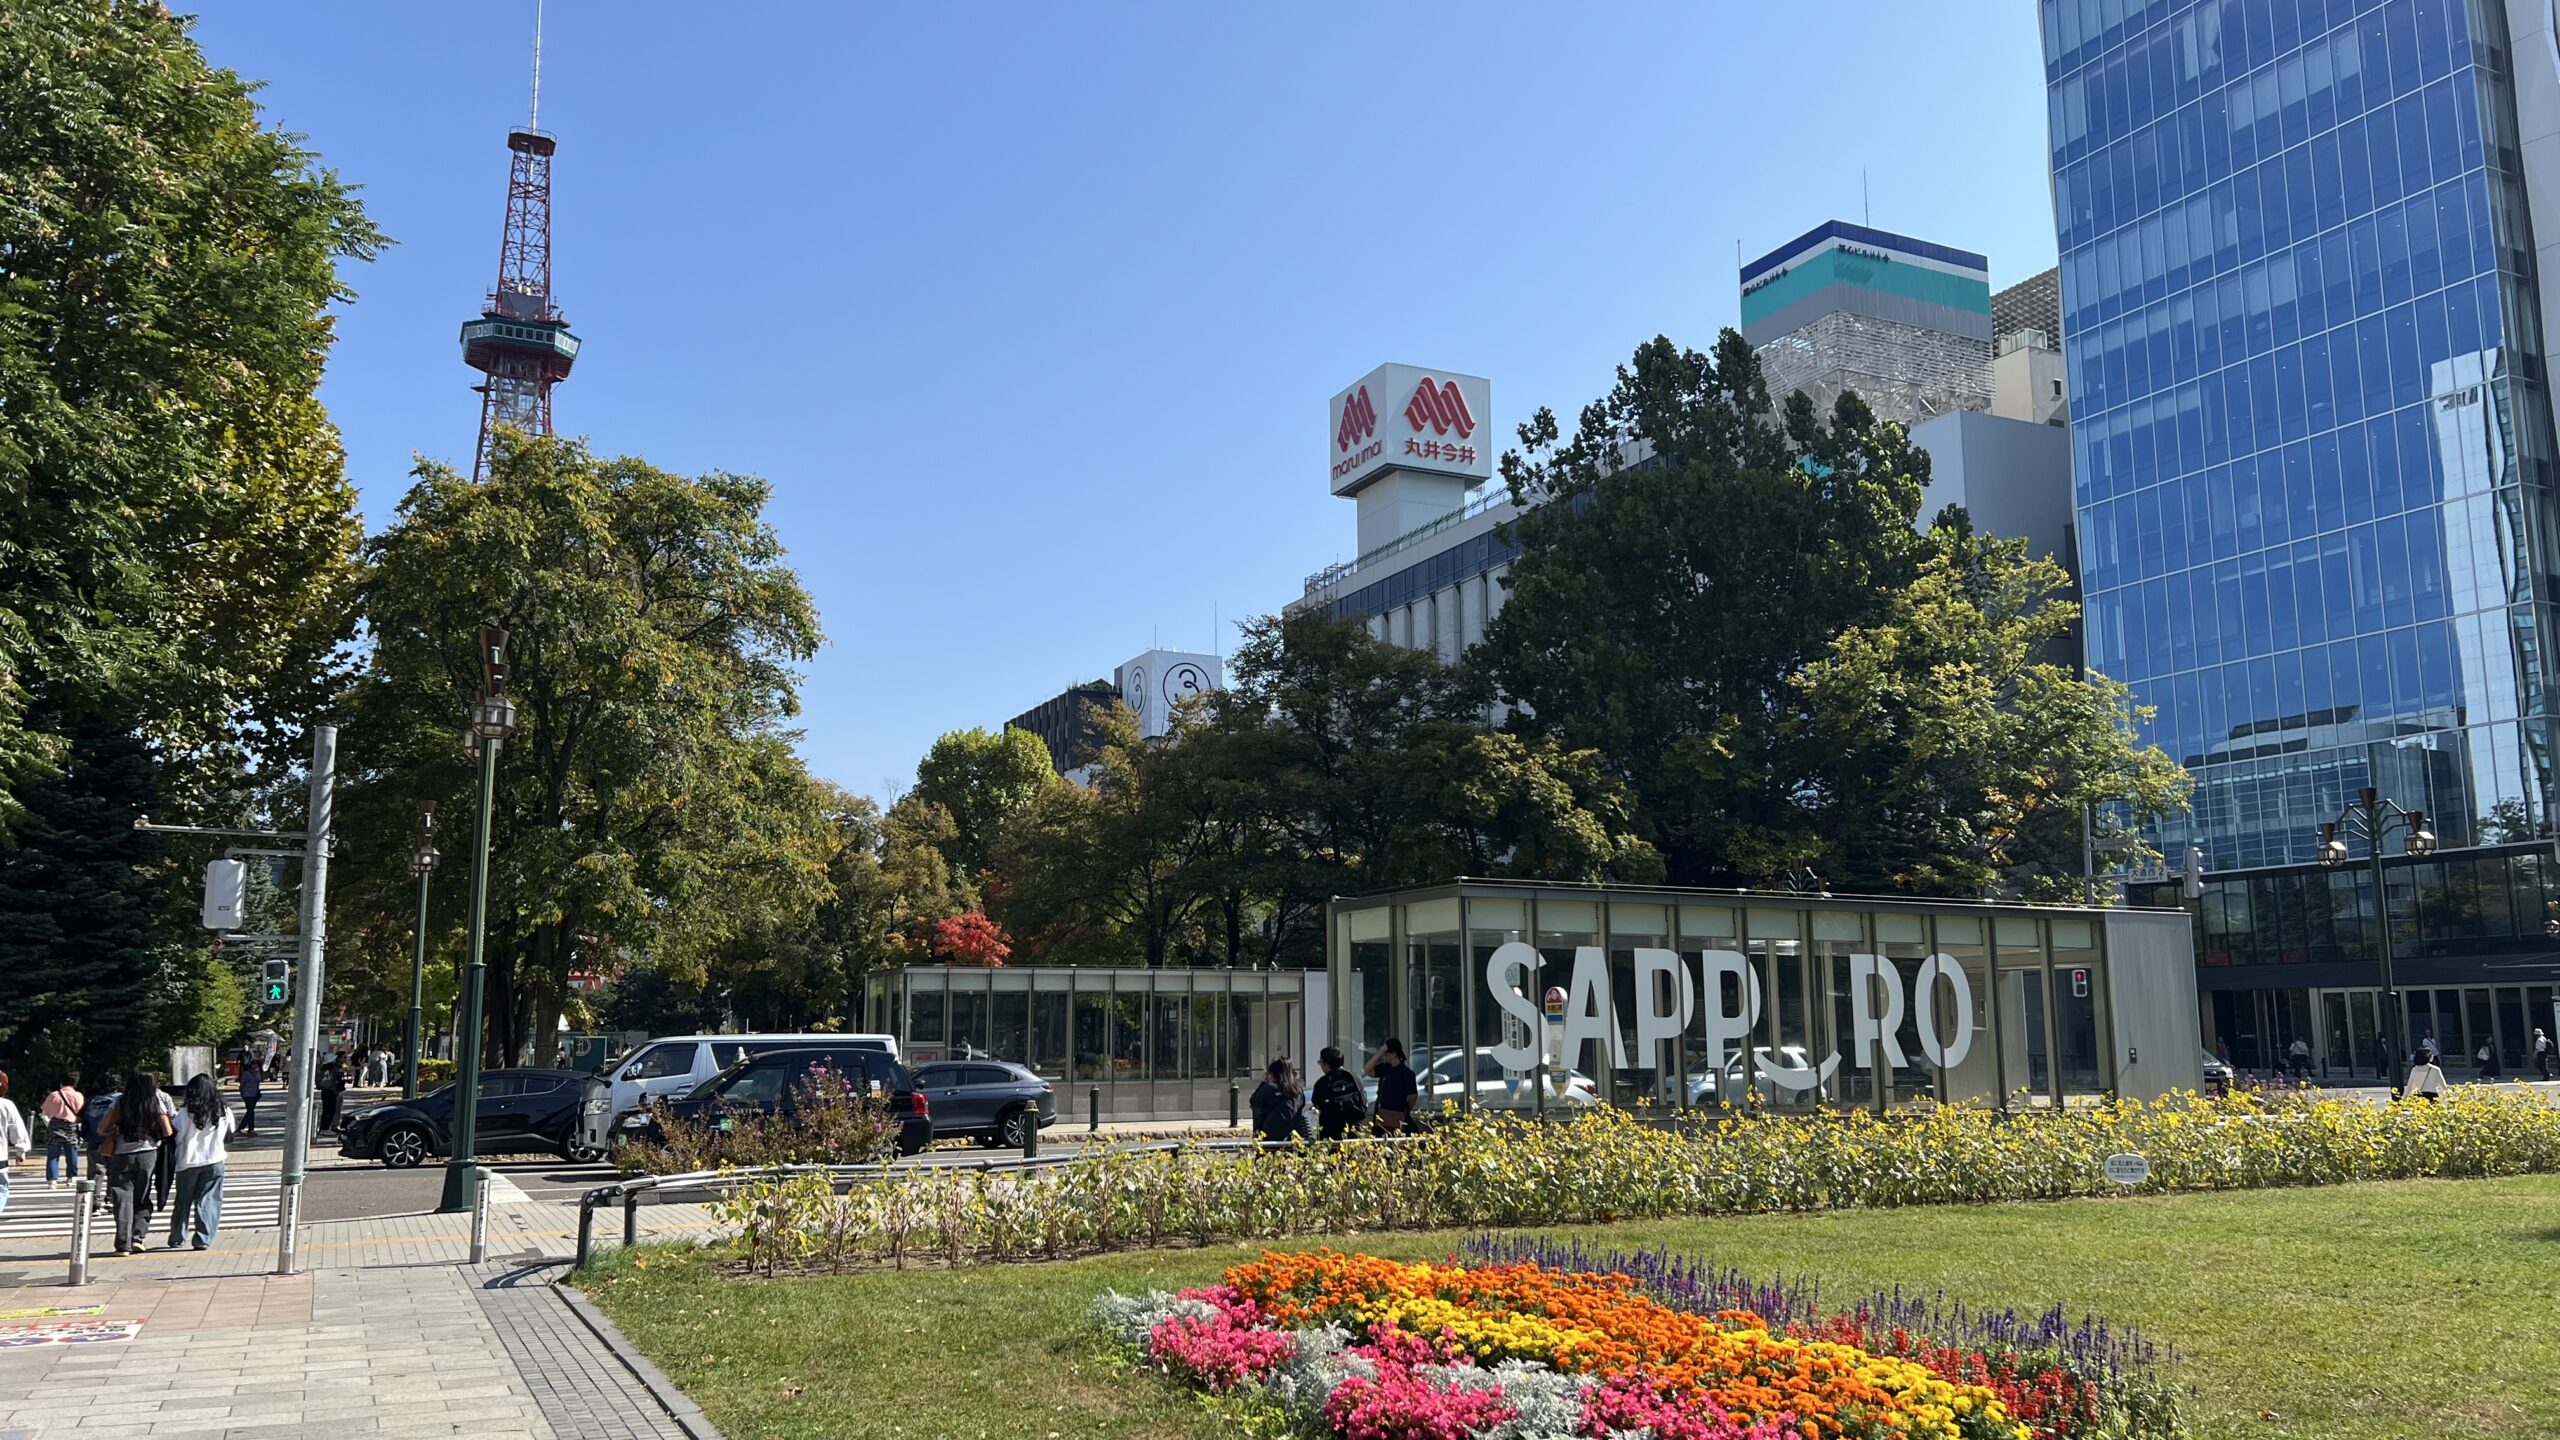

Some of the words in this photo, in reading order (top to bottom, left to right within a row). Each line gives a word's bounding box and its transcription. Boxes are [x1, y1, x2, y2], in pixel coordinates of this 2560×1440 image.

[1332, 454, 1360, 481] marui
[1361, 440, 1382, 464] imai
[1405, 438, 1476, 465] 丸井今井
[2158, 867, 2164, 876] 2
